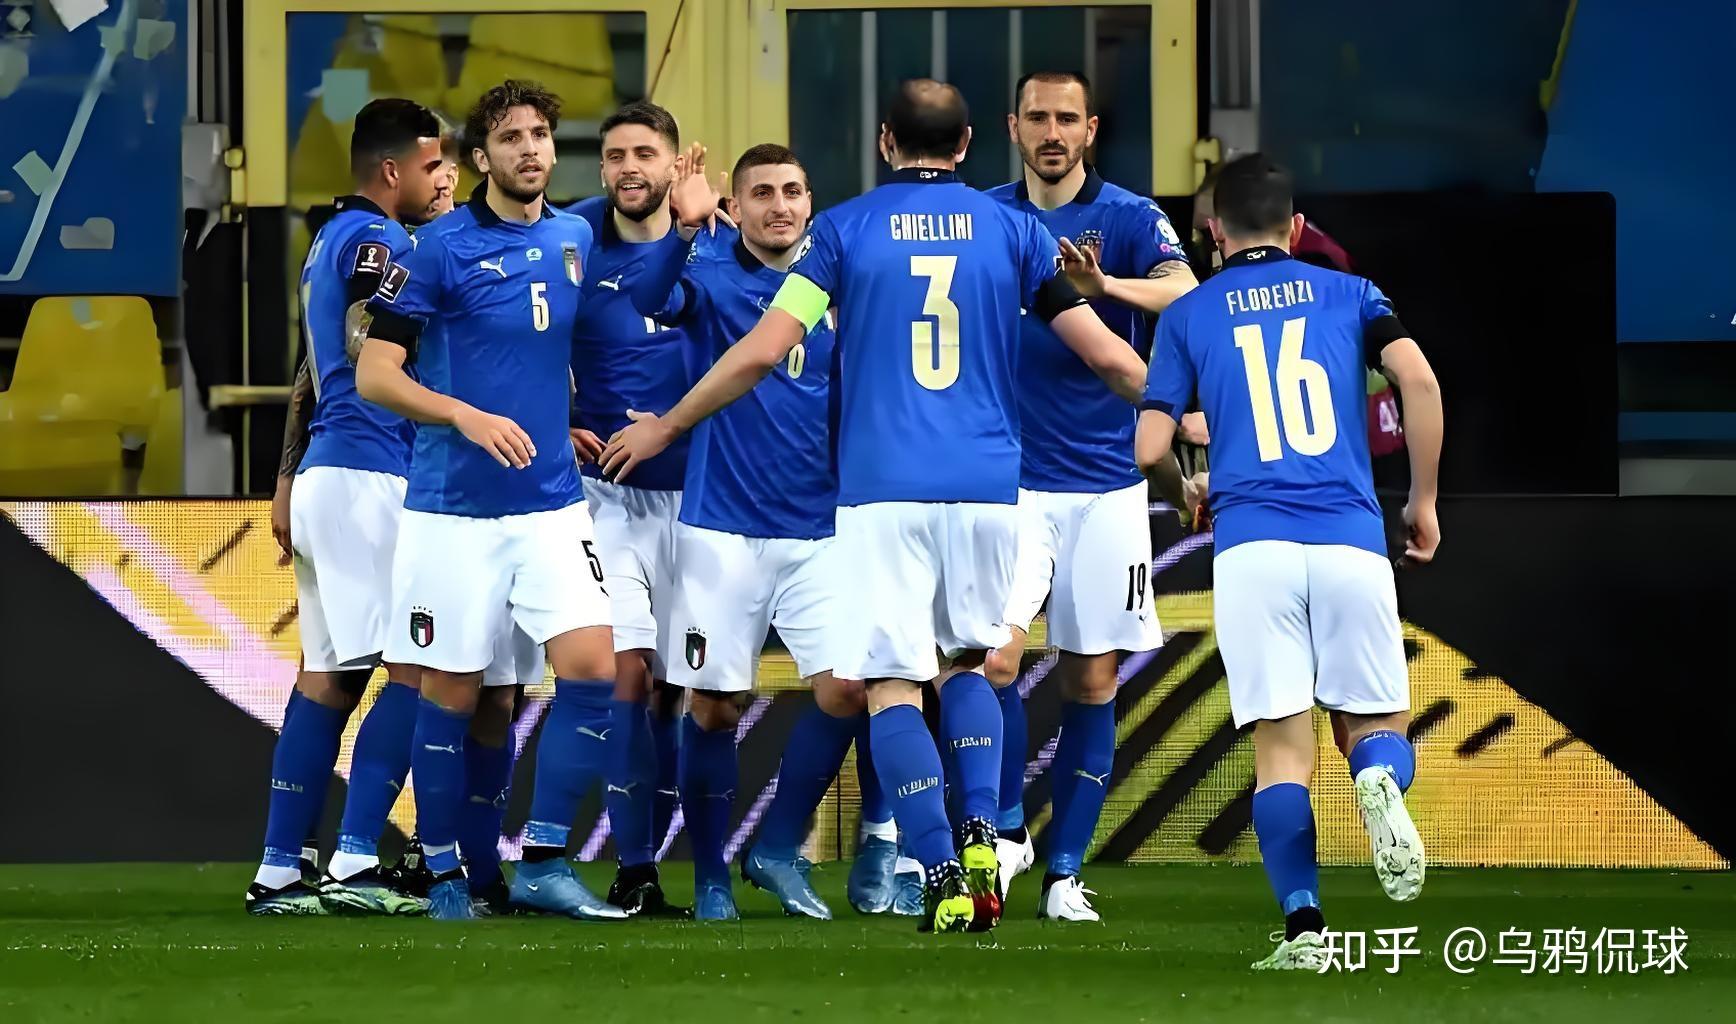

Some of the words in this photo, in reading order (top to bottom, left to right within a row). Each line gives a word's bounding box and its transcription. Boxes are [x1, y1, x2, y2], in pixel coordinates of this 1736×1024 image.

[890, 213, 972, 241] CHIELLINI
[530, 281, 550, 331] 5
[1226, 280, 1314, 315] FLORENZI
[910, 255, 960, 390] 3
[1233, 316, 1338, 462] 16
[581, 540, 604, 583] 5
[1126, 562, 1146, 611] 19
